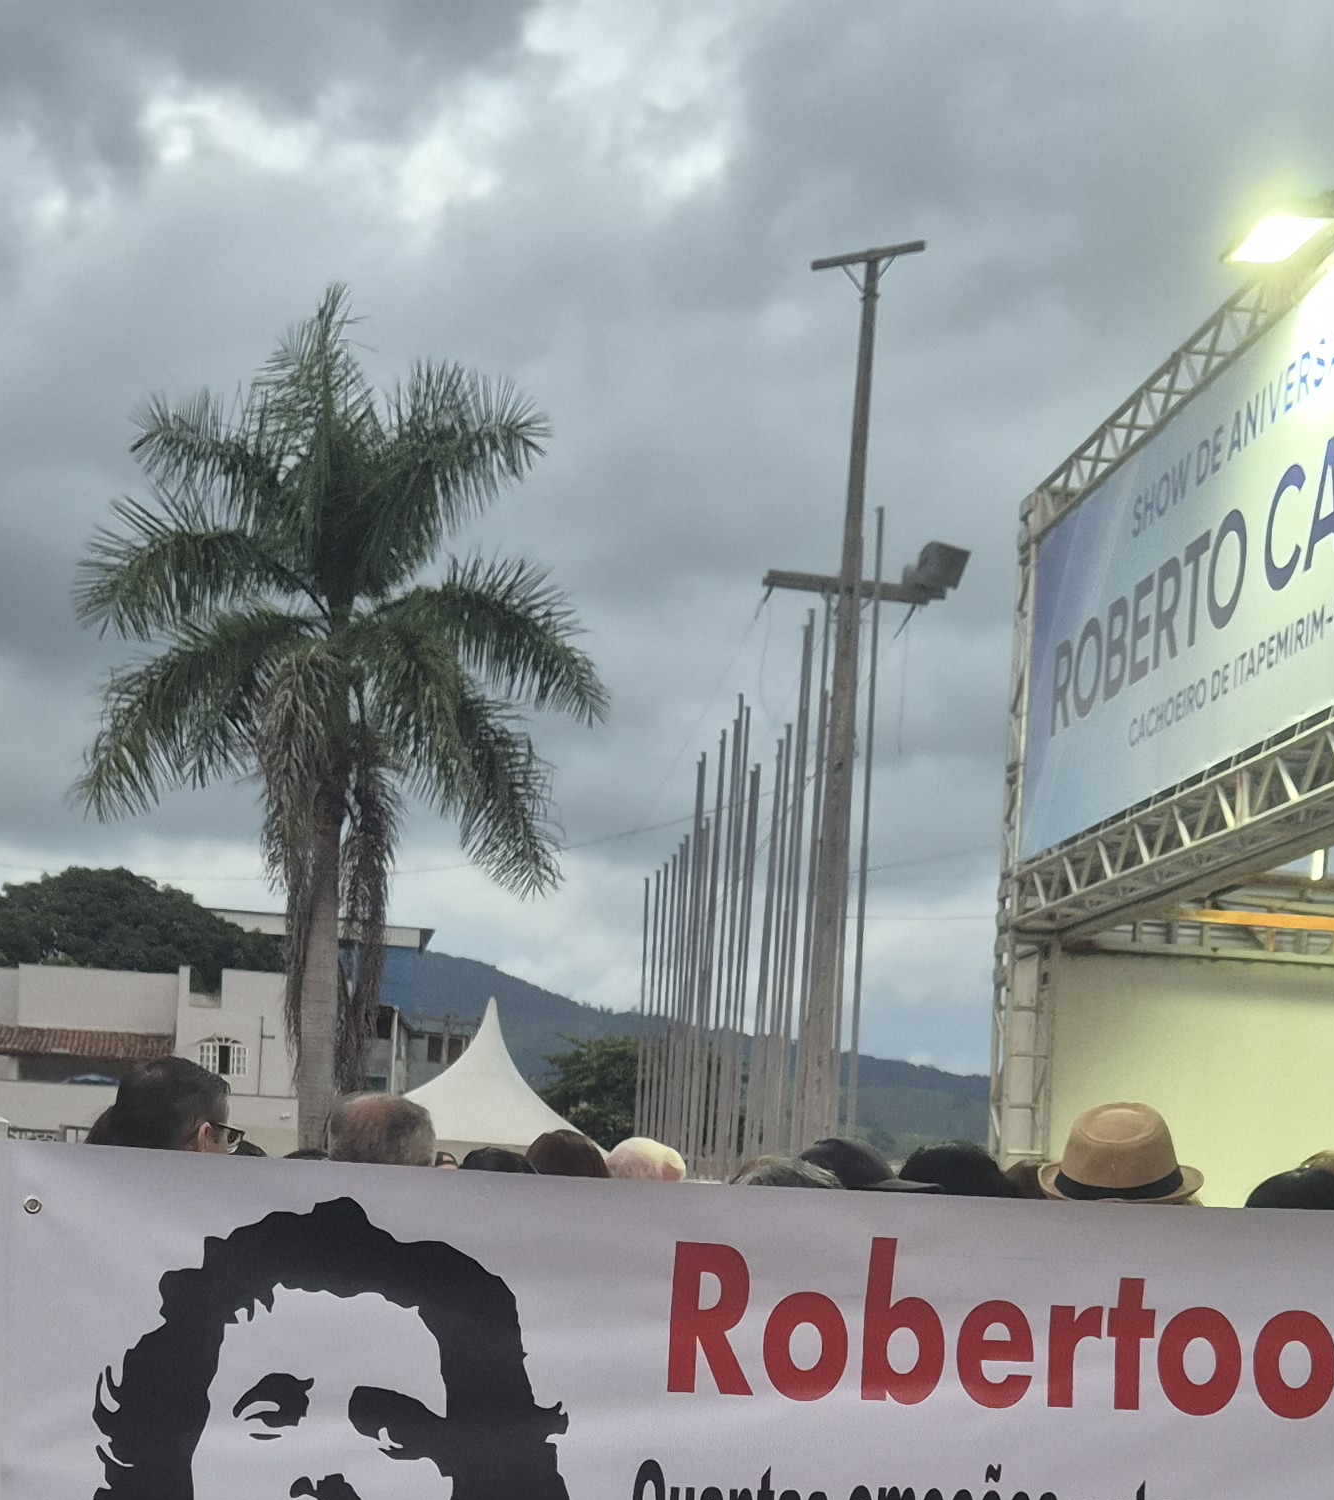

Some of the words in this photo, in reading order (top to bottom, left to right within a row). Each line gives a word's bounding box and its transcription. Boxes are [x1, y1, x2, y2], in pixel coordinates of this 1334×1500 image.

[1132, 452, 1192, 539] SHOW
[1196, 424, 1225, 488] DE
[1050, 508, 1248, 737] ROBERTO
[1128, 677, 1207, 748] CACHOEIRO
[1210, 663, 1231, 702] DE
